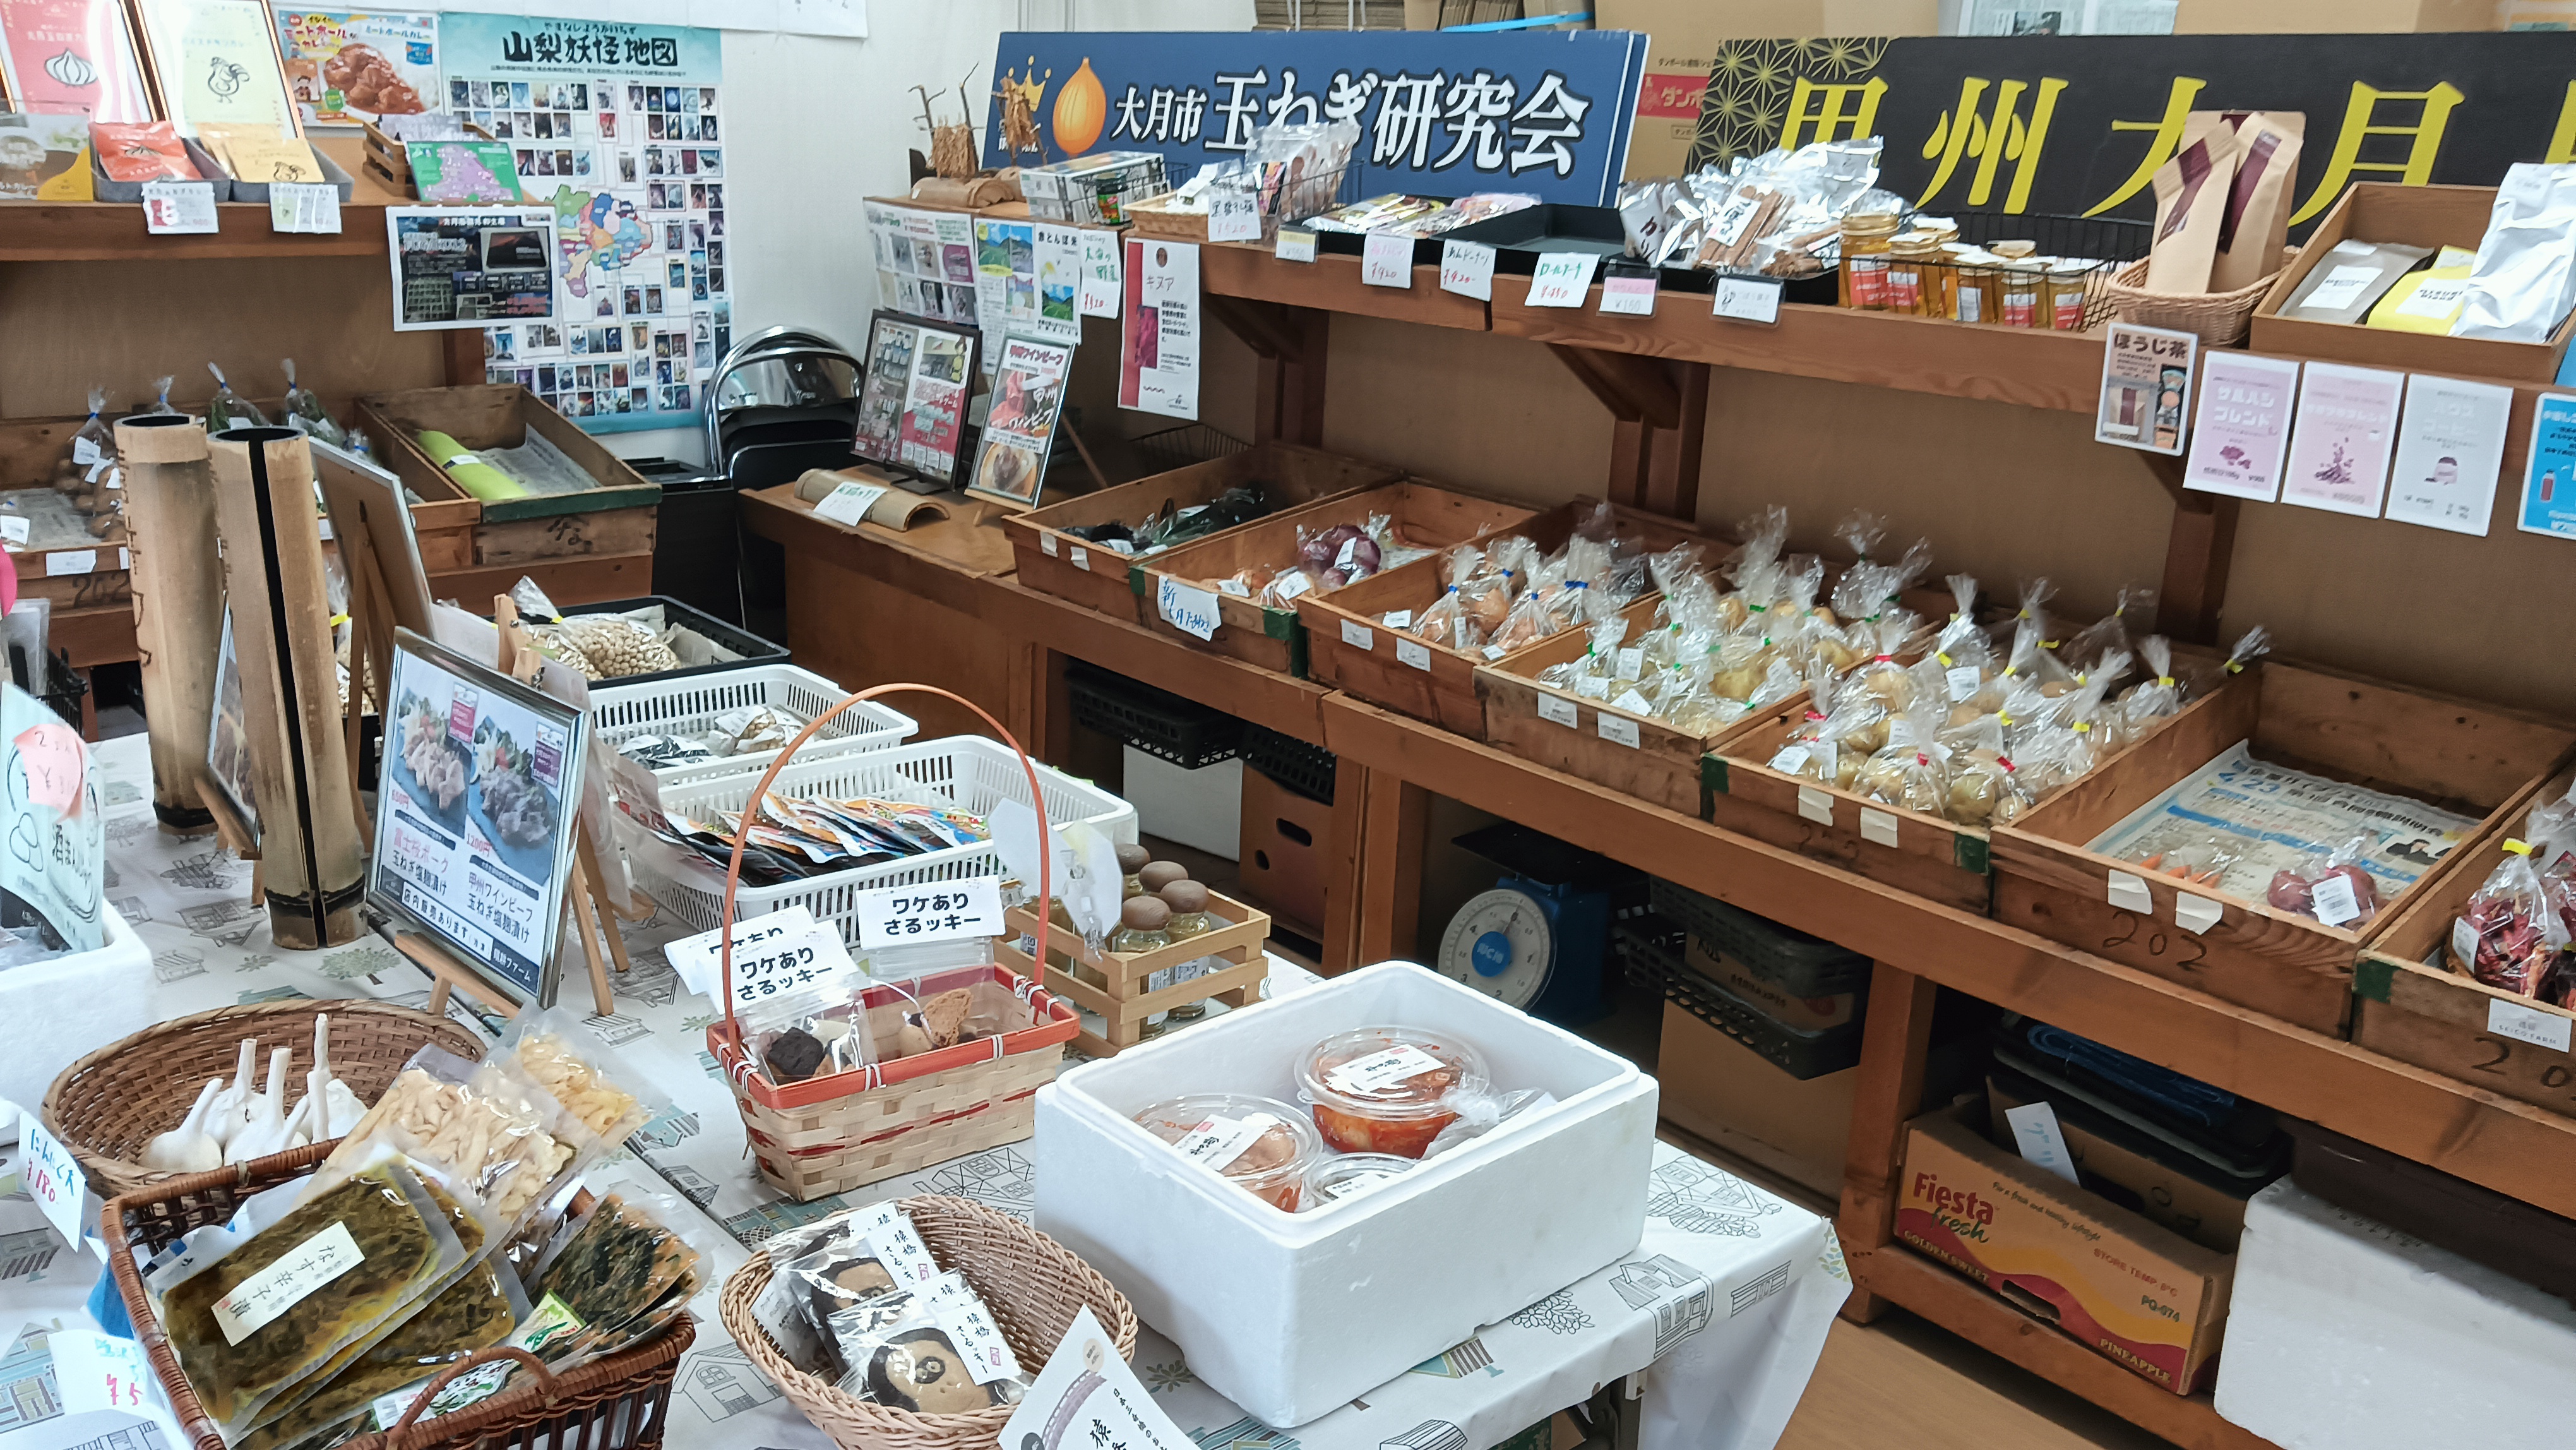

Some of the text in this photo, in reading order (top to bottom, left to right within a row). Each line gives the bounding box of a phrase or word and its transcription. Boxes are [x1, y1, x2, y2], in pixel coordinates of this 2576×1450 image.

[503, 31, 678, 66] 山梨妖怪地図
[1779, 74, 2576, 227] 甲州大月
[2114, 332, 2188, 360] ほうじ茶
[892, 892, 969, 915] ワケあり
[884, 914, 981, 935] さるッキー
[2103, 911, 2208, 971] 202
[739, 947, 815, 978] ワケあり
[737, 966, 833, 1000] さるッキー
[2471, 1037, 2576, 1103] 20
[1913, 1171, 1994, 1225] Fiesta
[1929, 1206, 1991, 1244] fresh
[894, 1230, 917, 1256] 猿橋
[2094, 1248, 2127, 1271] STORE
[884, 1245, 915, 1285] さるッキ
[967, 1312, 990, 1338] 猿橋
[2100, 1338, 2171, 1384] PINEAPPLE
